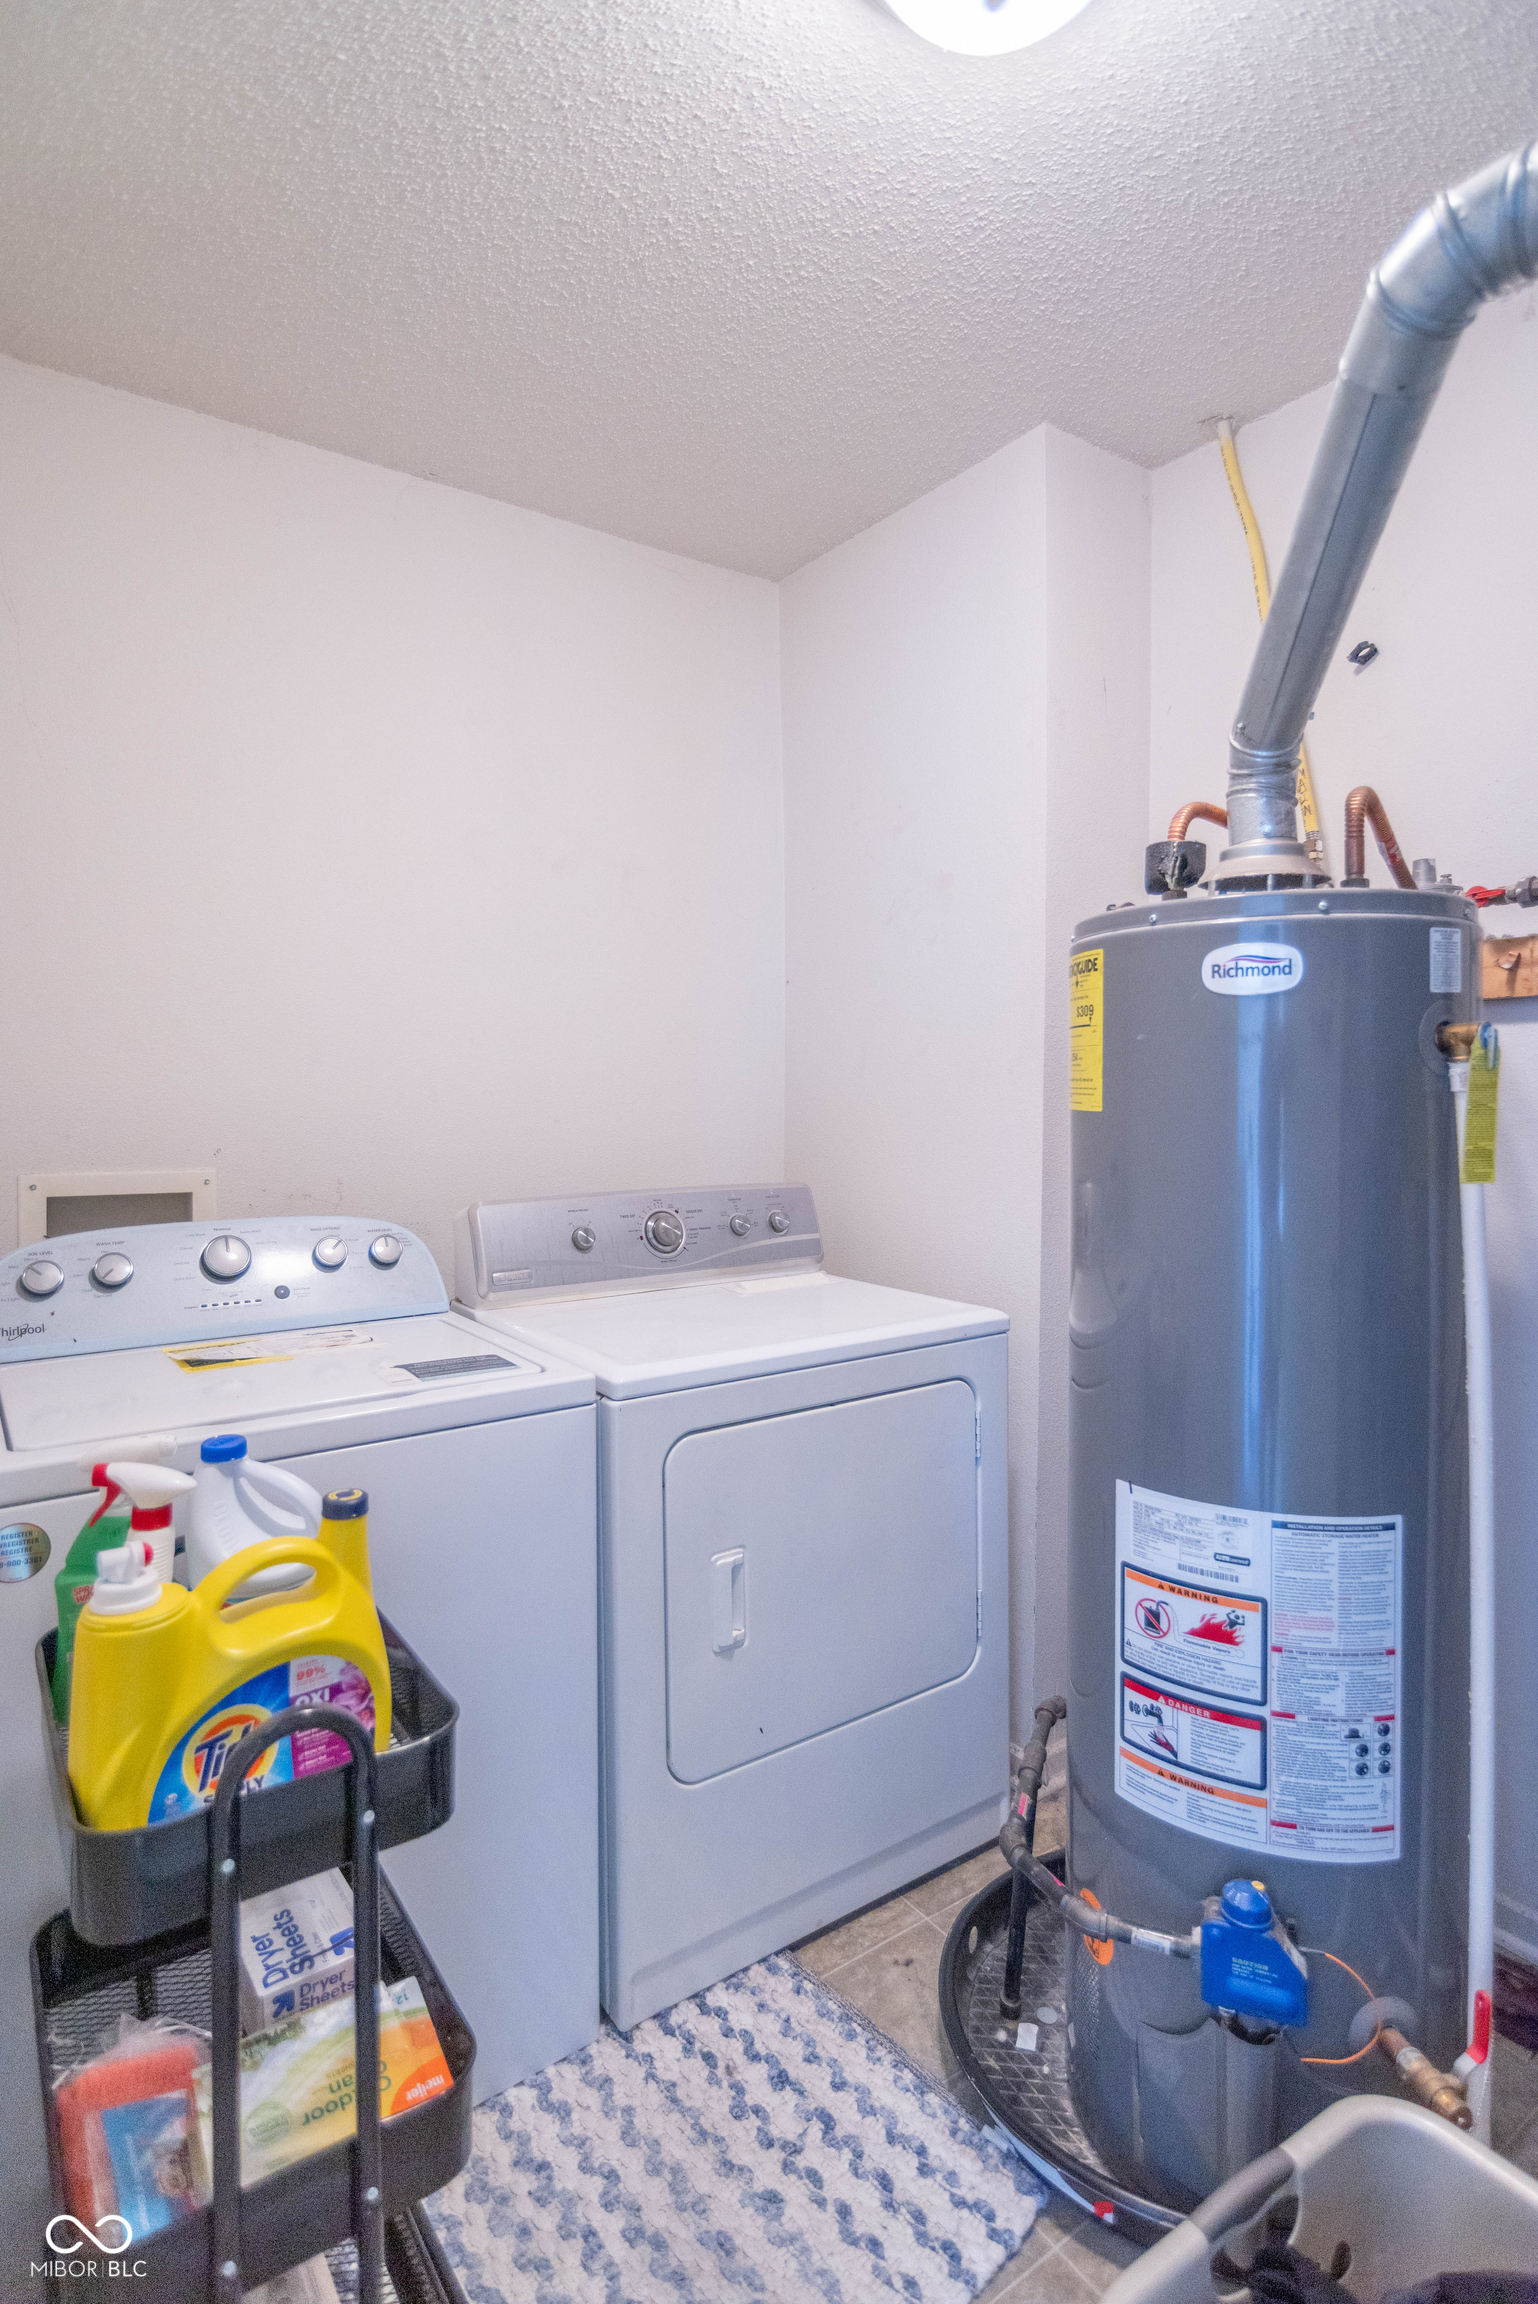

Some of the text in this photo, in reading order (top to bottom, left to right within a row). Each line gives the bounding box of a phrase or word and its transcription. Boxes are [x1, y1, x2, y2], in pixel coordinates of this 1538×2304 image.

[1211, 958, 1292, 979] Richmond
[0, 1324, 45, 1337] hirlpool
[1, 1531, 33, 1540] REGISTER
[1169, 1585, 1218, 1604] WARNING
[296, 1665, 325, 1681] 99%
[294, 1688, 331, 1707] OXI
[1168, 1699, 1210, 1718] DANGER
[194, 1722, 255, 1793] Ti
[1169, 1773, 1215, 1794] WARNING
[272, 1908, 316, 1976] Sheets
[250, 1932, 290, 1989] Dryer
[299, 1969, 347, 1999] Dryer
[299, 1979, 355, 2012] Sheets
[405, 2074, 445, 2101] meijer
